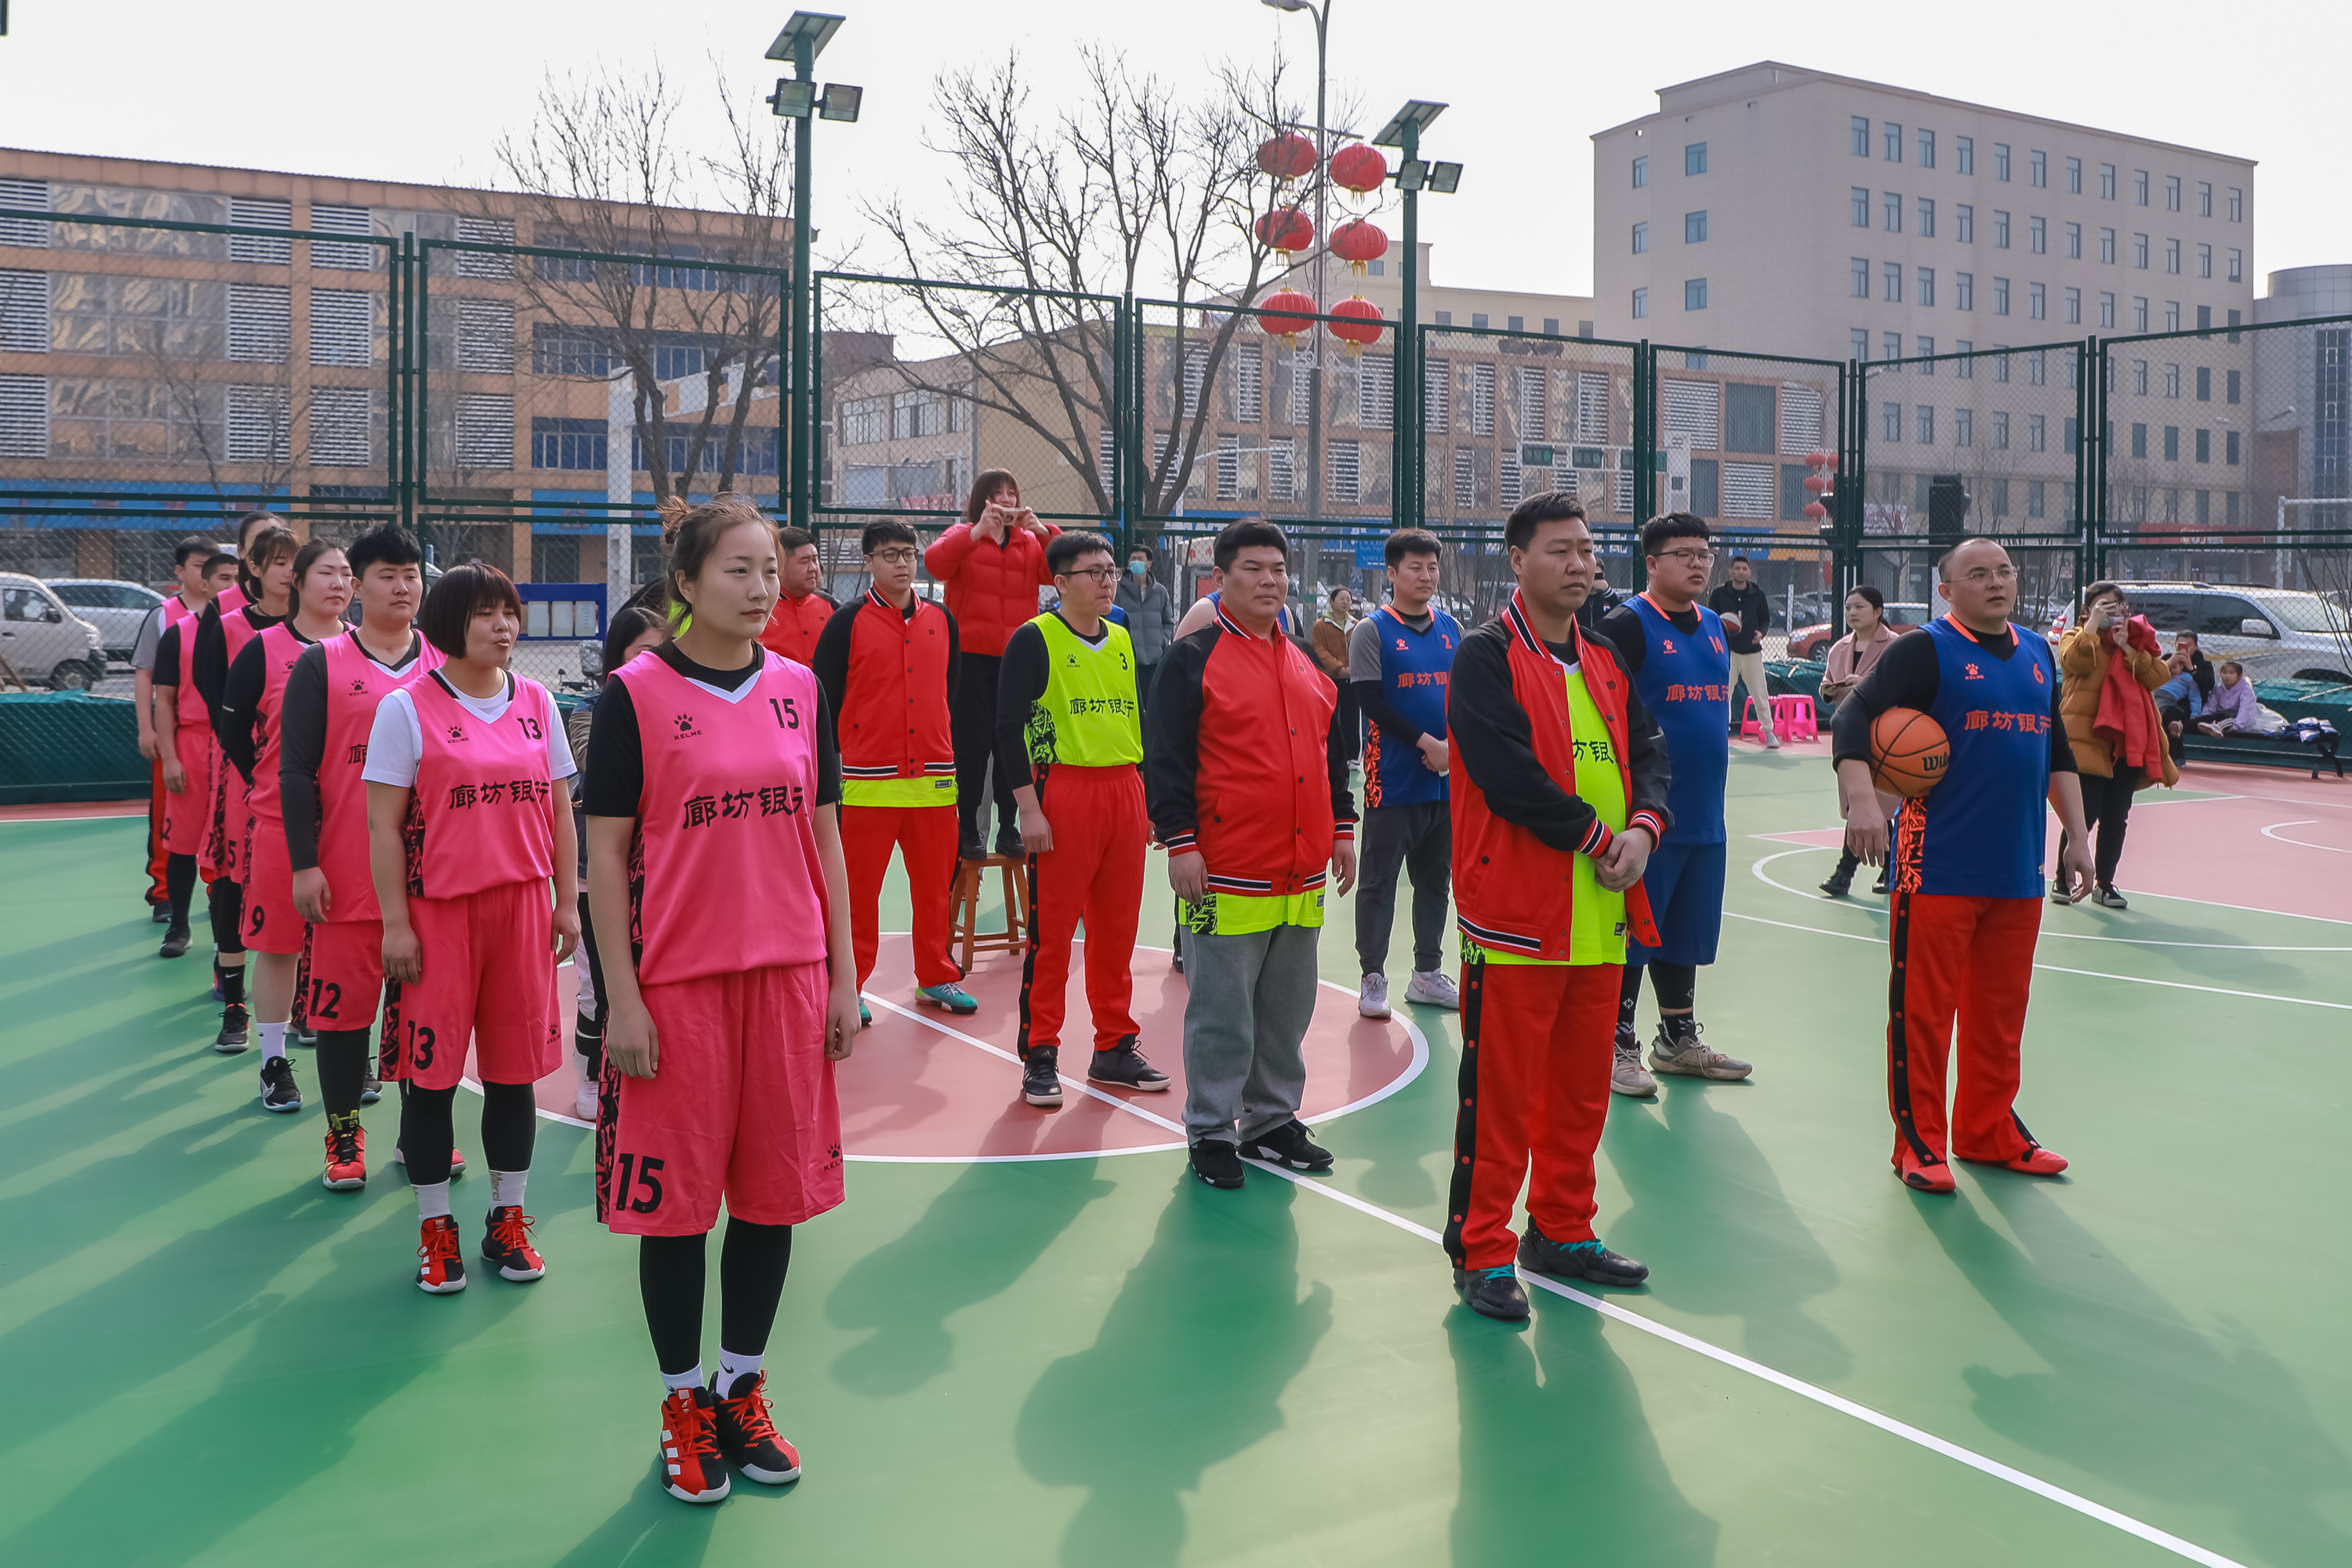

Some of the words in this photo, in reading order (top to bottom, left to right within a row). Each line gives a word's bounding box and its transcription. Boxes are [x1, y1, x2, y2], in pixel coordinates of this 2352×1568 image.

[1441, 633, 1453, 650] 2
[1708, 636, 1724, 654] 14
[1119, 652, 1128, 670] 3
[2033, 663, 2044, 684] 6
[769, 699, 800, 730] 15
[1069, 698, 1134, 718] 廊坊银行
[517, 717, 543, 740] 13
[673, 730, 702, 741] KELME
[448, 780, 550, 810] 廊坊银行
[249, 905, 265, 937] 9
[309, 978, 342, 1019] 12
[408, 1019, 435, 1070] 13
[614, 1152, 665, 1214] 15
